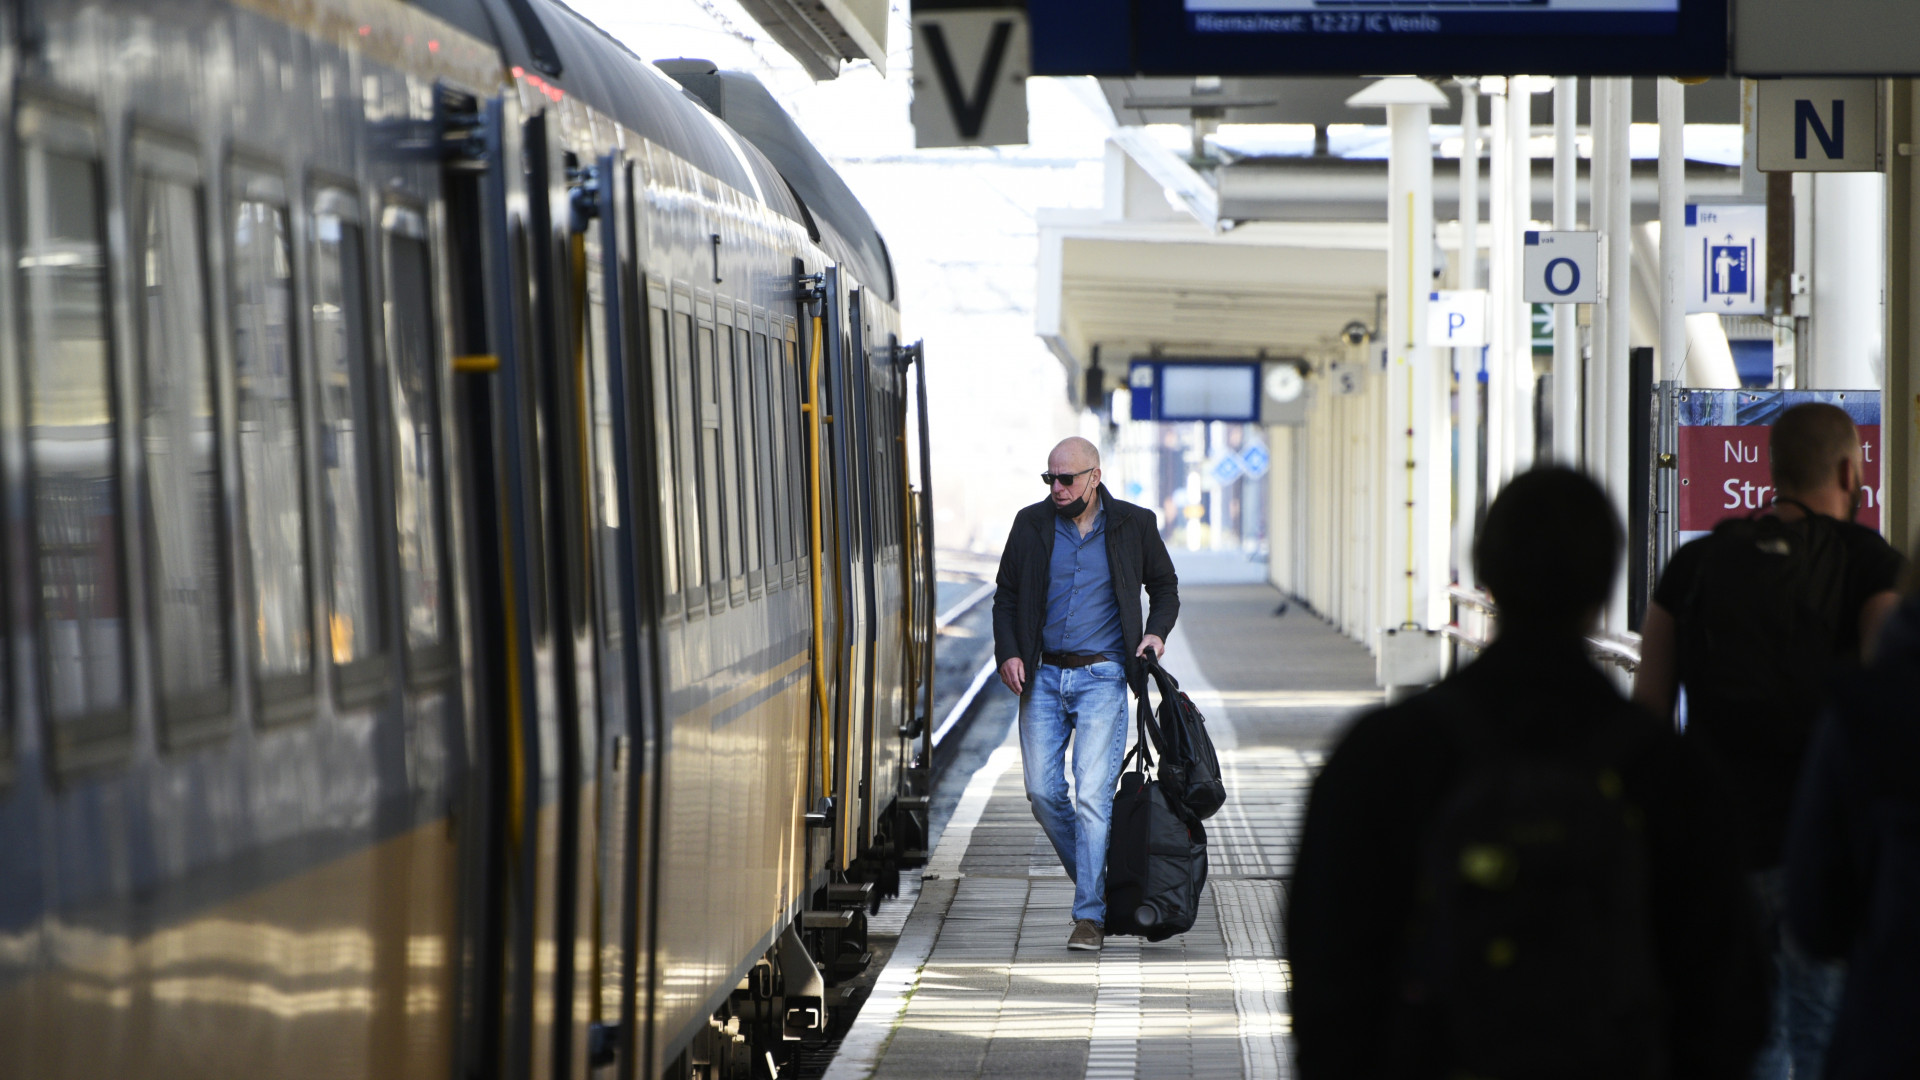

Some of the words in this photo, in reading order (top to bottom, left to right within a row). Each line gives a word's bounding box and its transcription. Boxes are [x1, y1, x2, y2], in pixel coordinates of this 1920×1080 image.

[1311, 13, 1361, 32] 12:27
[1364, 13, 1384, 32] IC
[1387, 13, 1439, 32] Venlo
[919, 19, 1013, 140] V
[1794, 99, 1844, 159] N
[1700, 212, 1717, 223] lift
[1544, 257, 1580, 296] O
[1448, 312, 1465, 338] P
[1724, 440, 1758, 463] Nu
